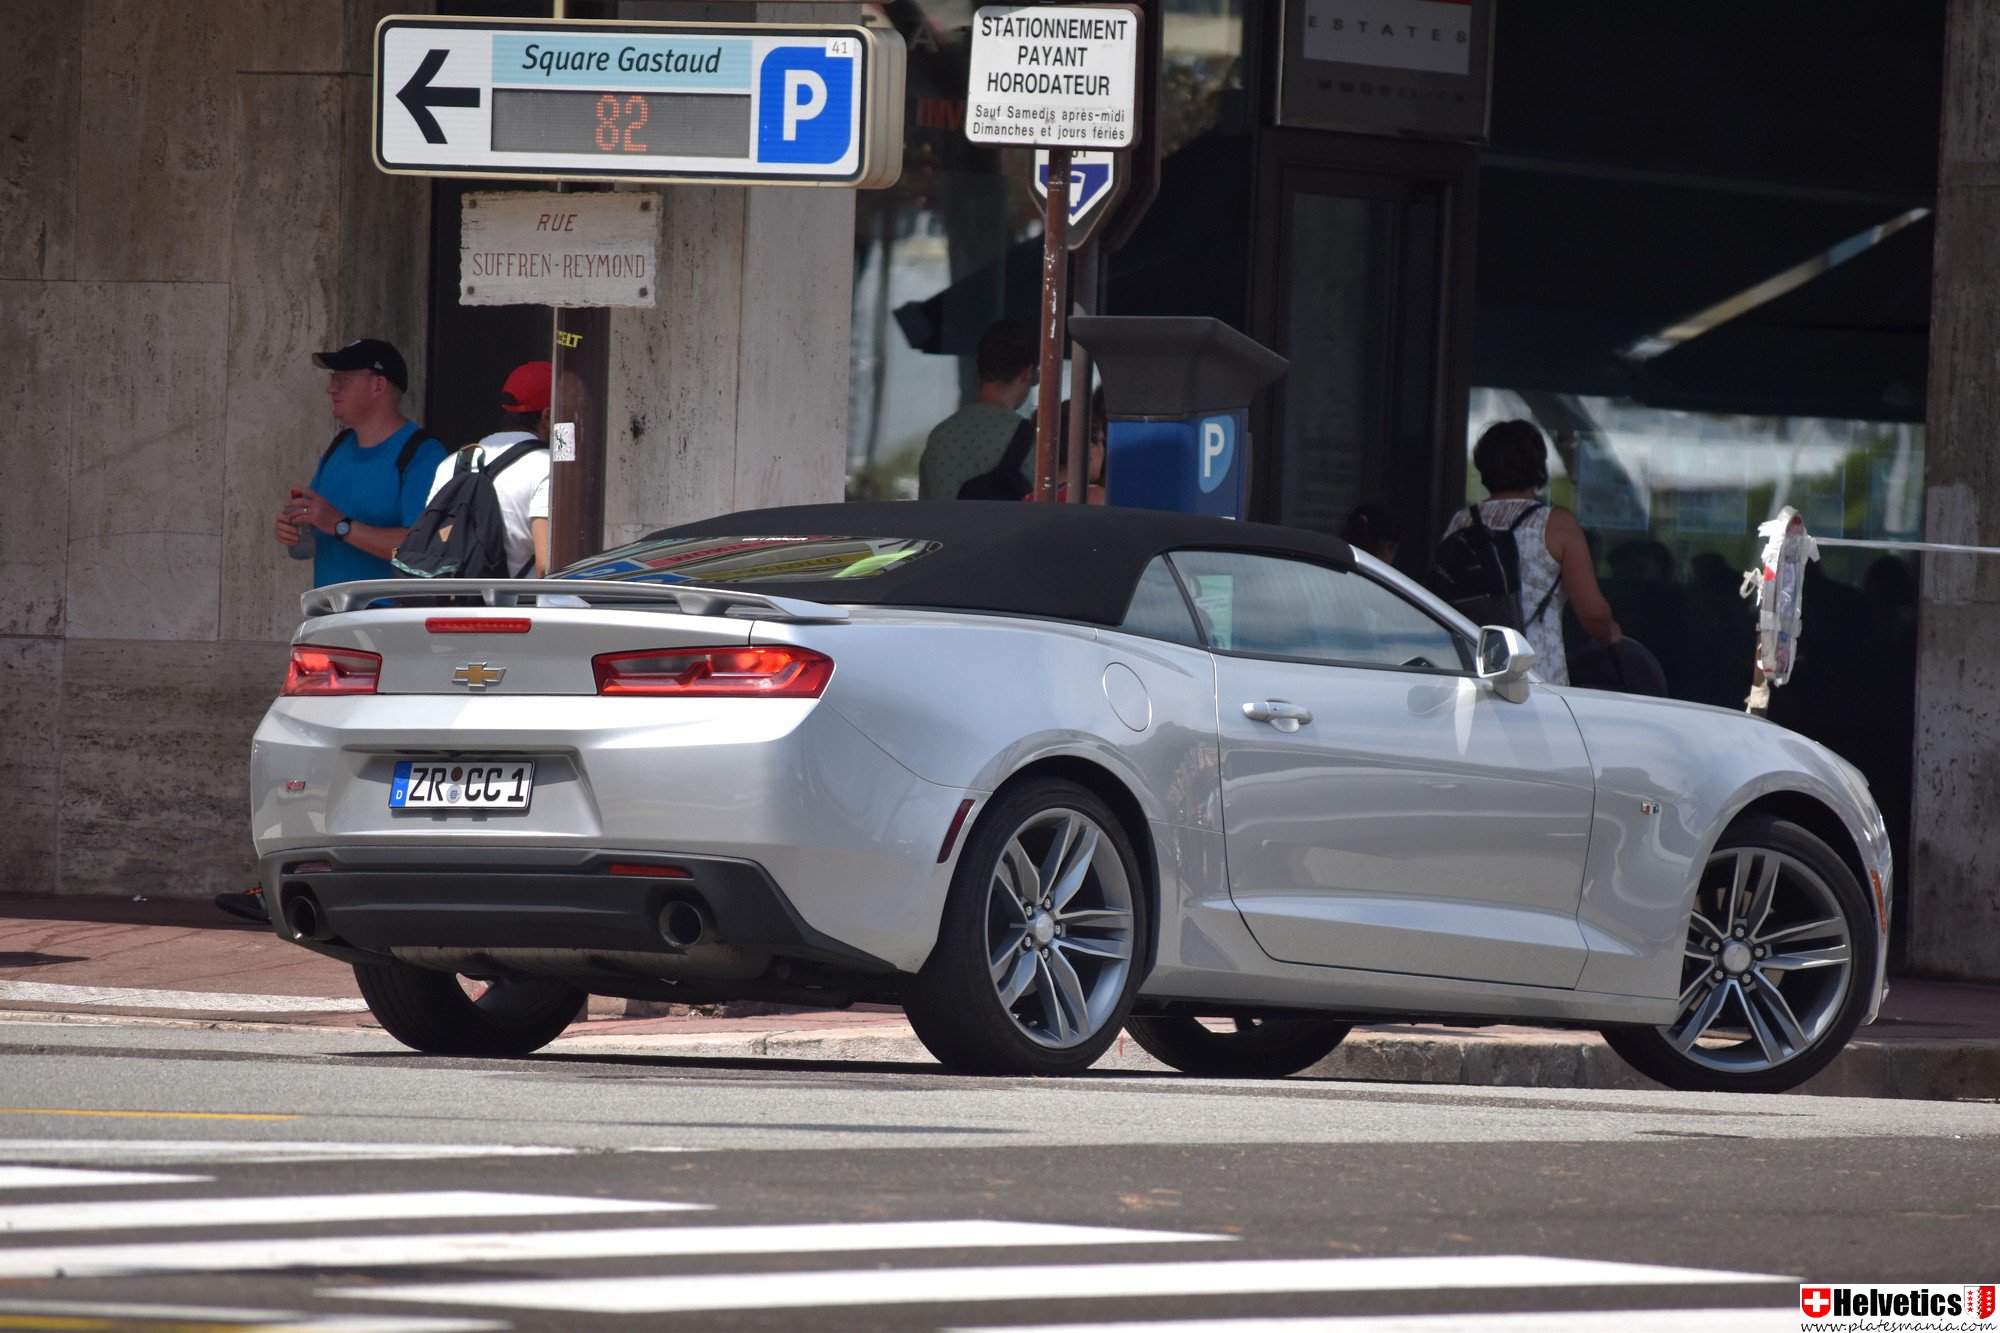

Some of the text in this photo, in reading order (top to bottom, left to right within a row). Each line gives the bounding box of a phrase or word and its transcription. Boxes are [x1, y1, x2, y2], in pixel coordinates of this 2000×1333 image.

[981, 16, 1128, 40] STATIONNEMENT
[1307, 15, 1468, 44] ESTATES
[522, 43, 722, 76] Square Gastaud
[832, 41, 848, 55] 41
[1017, 45, 1088, 67] PAYANT
[987, 72, 1110, 96] HORODATEUR
[783, 69, 828, 141] P
[975, 104, 1125, 123] Sauf Samedis après-midi
[596, 94, 648, 152] 82
[973, 122, 1125, 140] Dimanches et jours fériés
[537, 213, 578, 232] RUE
[1204, 423, 1226, 478] P
[395, 789, 403, 800] D
[409, 767, 447, 802] ZR
[464, 767, 503, 802] CC
[507, 767, 525, 802] 1
